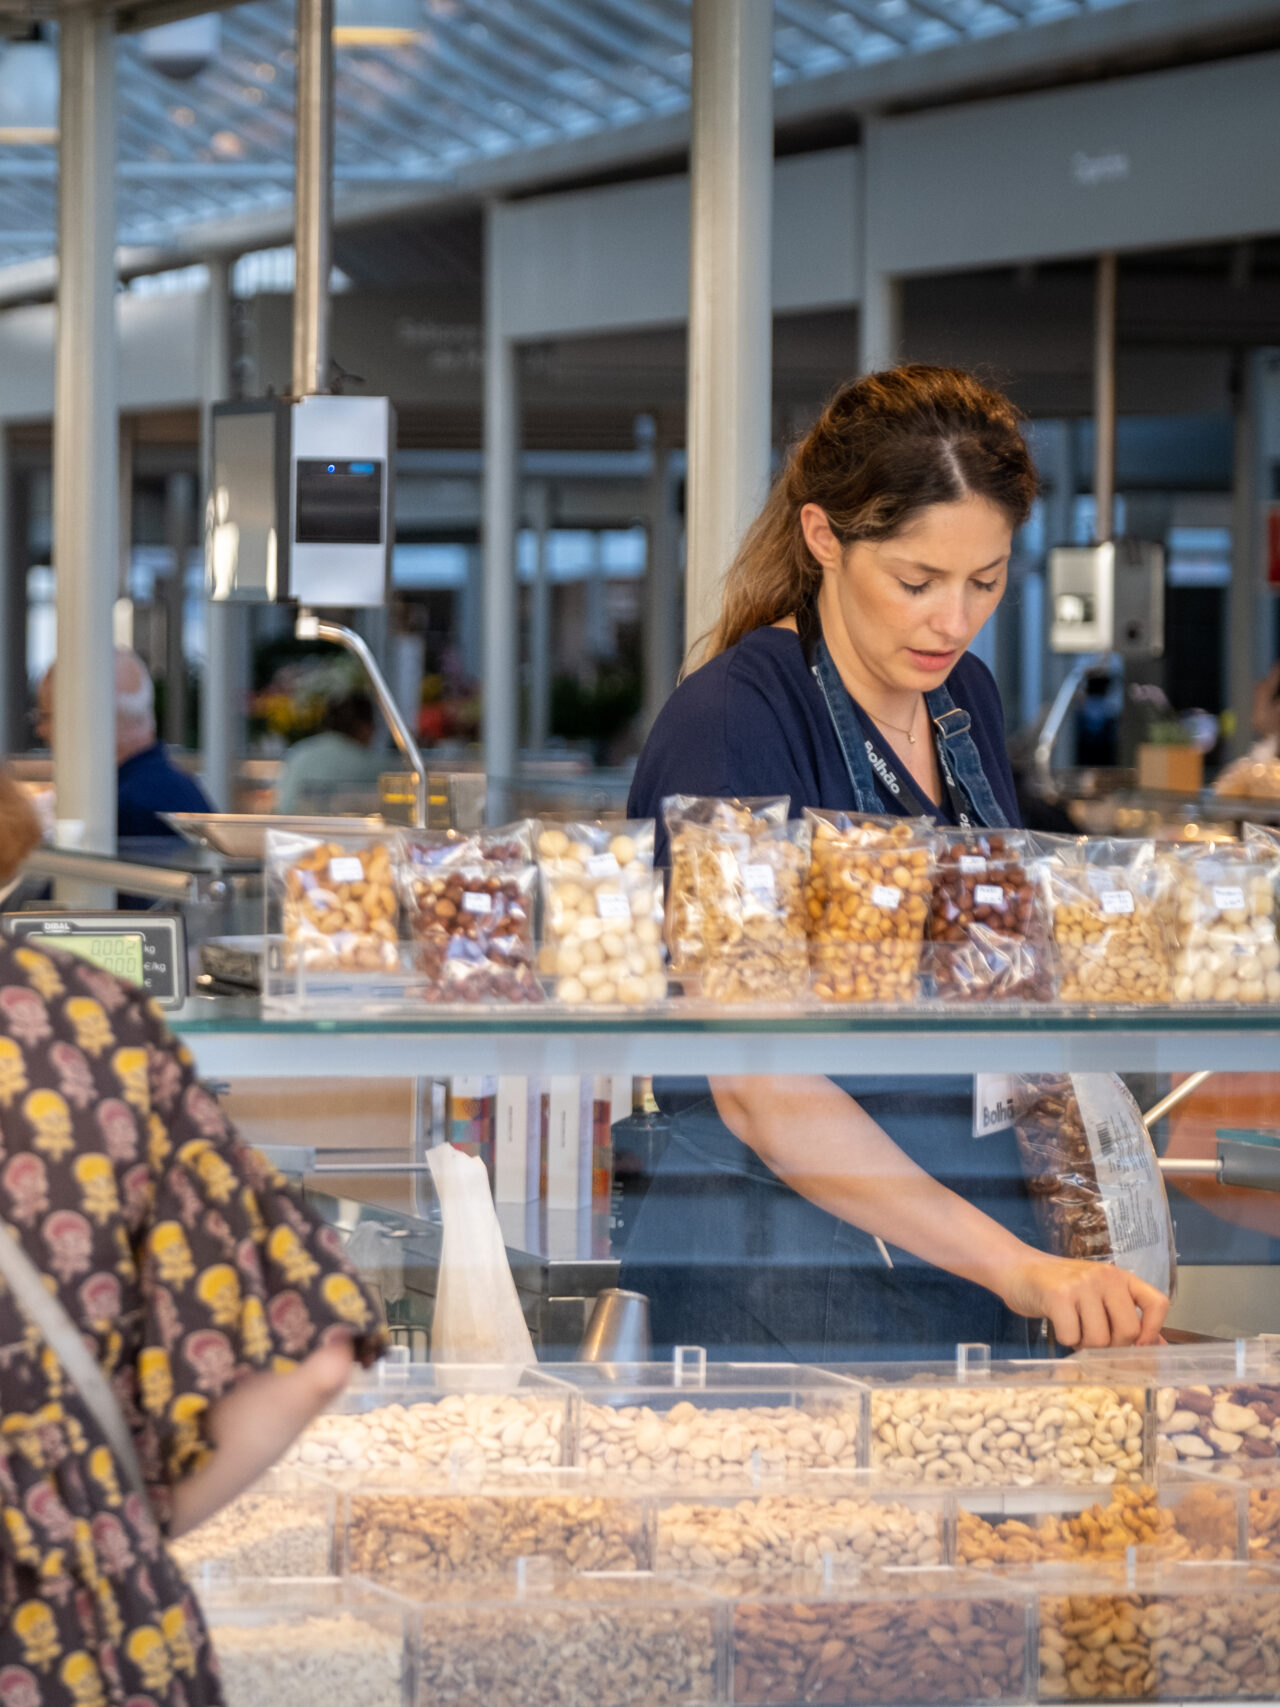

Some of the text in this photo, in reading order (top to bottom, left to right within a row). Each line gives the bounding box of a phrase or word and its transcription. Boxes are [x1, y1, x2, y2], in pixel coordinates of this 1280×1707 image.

[44, 922, 70, 930] DIBAL
[144, 944, 156, 955] kg
[144, 961, 167, 973] €/kg
[144, 978, 152, 988] €
